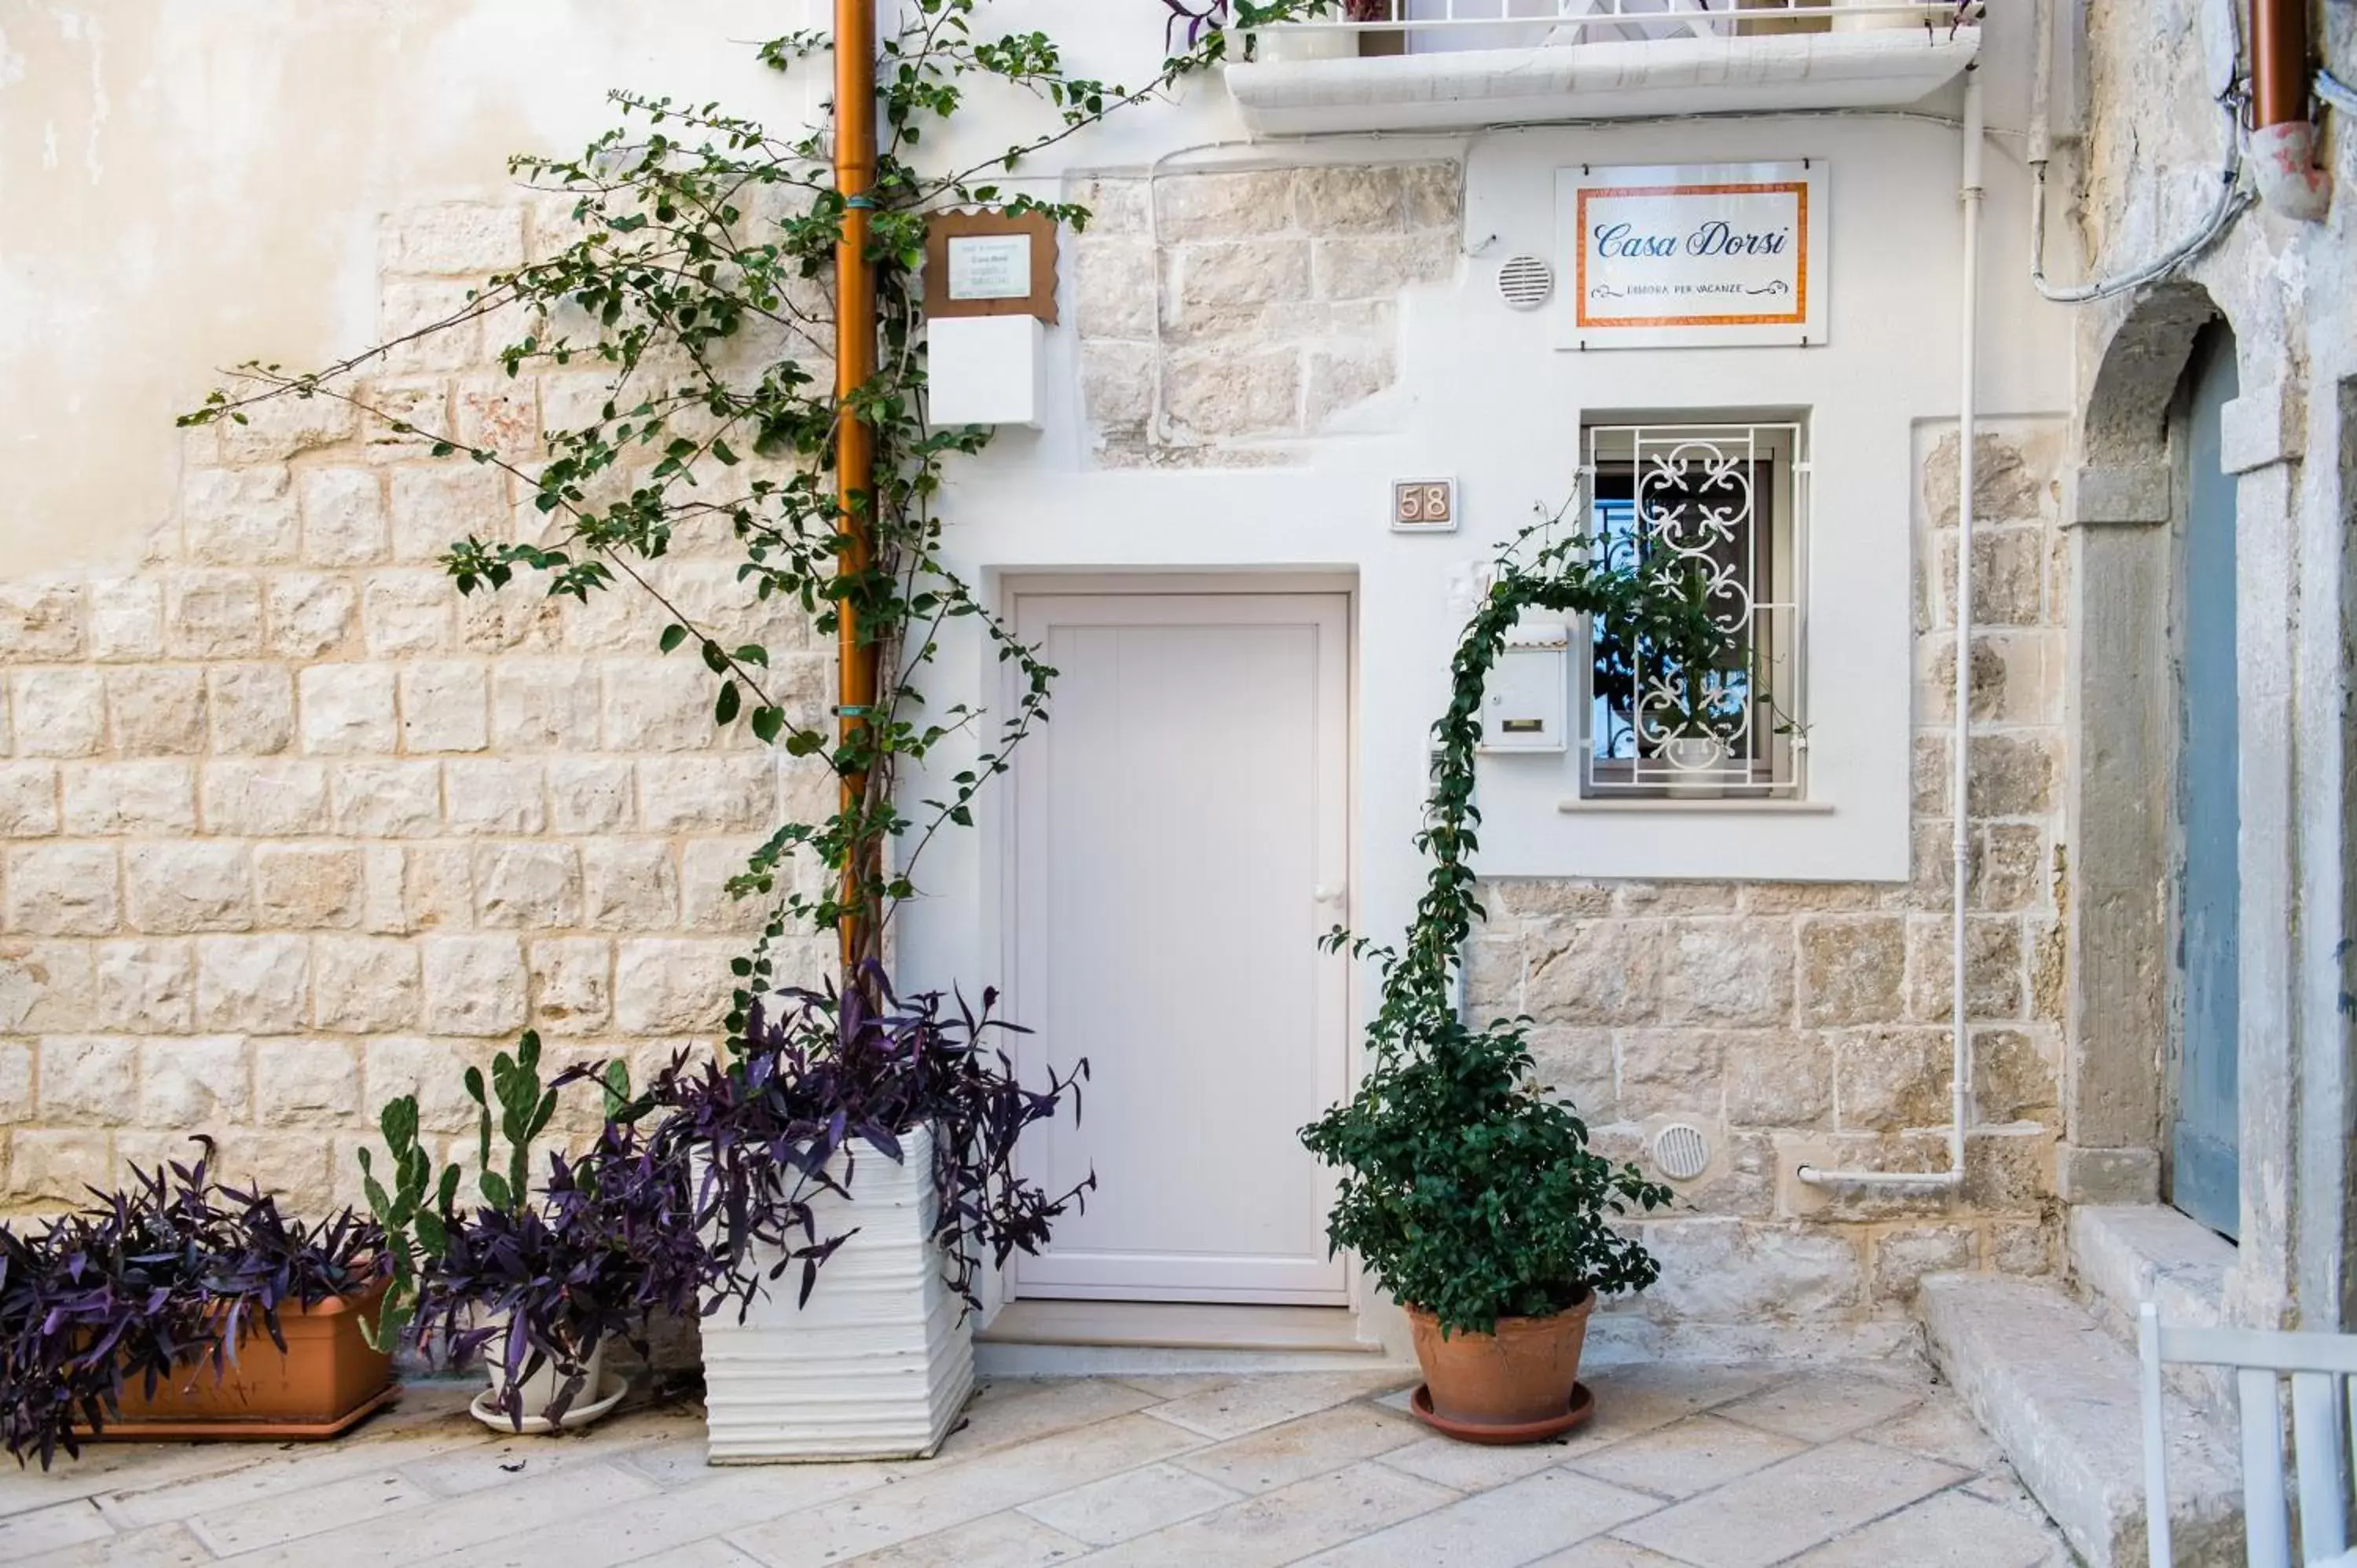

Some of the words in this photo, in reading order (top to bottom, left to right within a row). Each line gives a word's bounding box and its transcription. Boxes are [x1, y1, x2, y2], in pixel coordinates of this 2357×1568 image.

[1593, 222, 1678, 258] Casa
[1685, 221, 1789, 256] Dorsi
[1674, 284, 1692, 294] PER
[1696, 283, 1744, 294] VACANZE
[1401, 487, 1446, 518] 58
